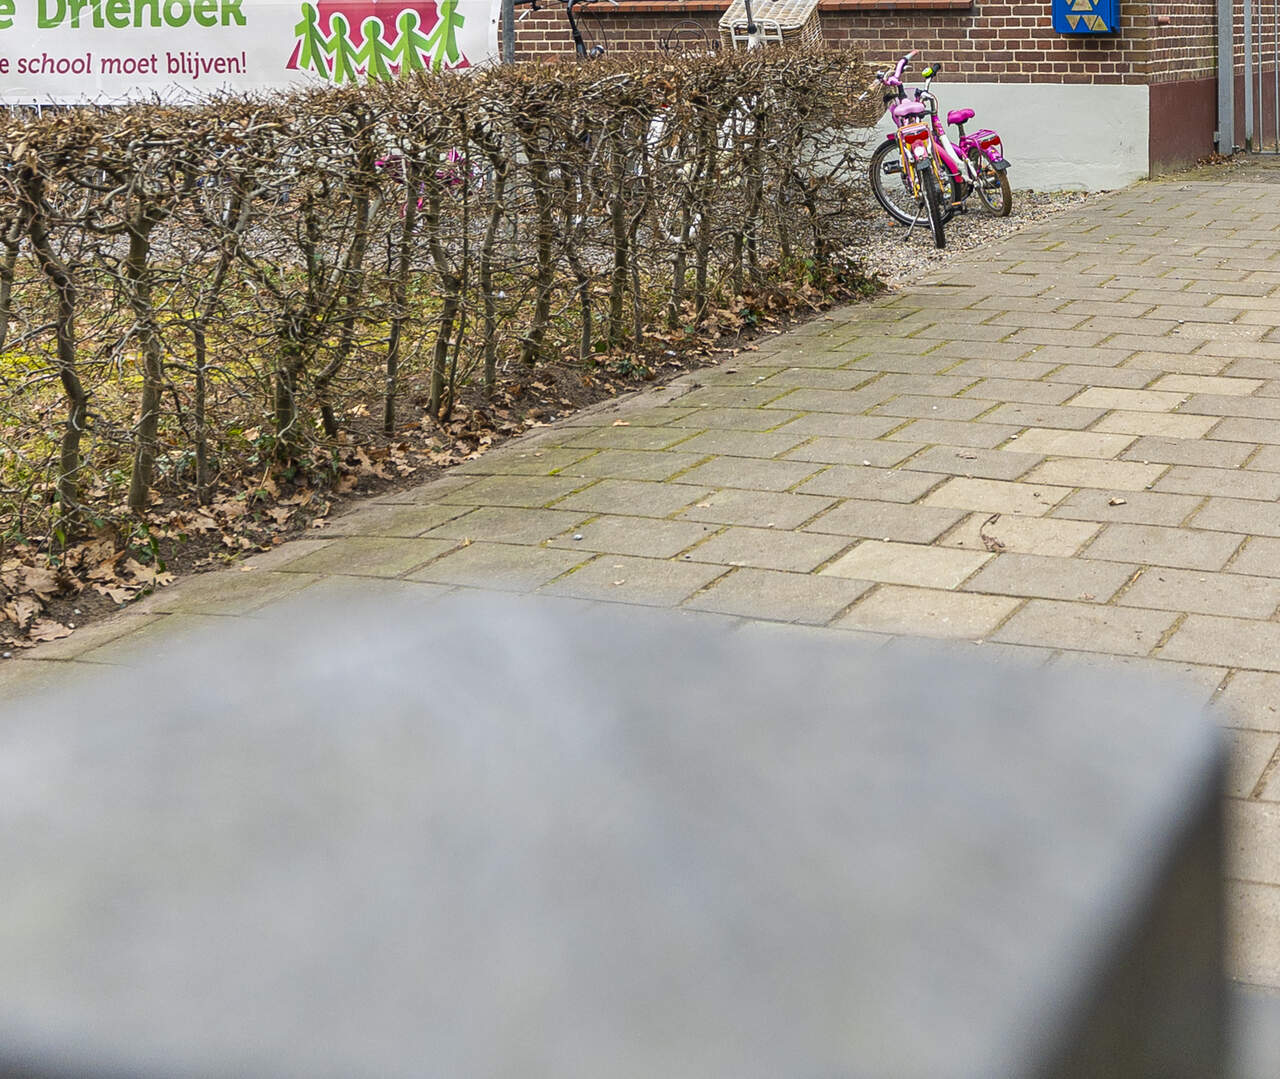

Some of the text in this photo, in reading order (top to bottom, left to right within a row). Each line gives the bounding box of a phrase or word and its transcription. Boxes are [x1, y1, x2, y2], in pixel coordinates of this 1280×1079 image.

[17, 52, 92, 75] school
[101, 54, 158, 74] moet
[166, 51, 247, 80] blijven!
